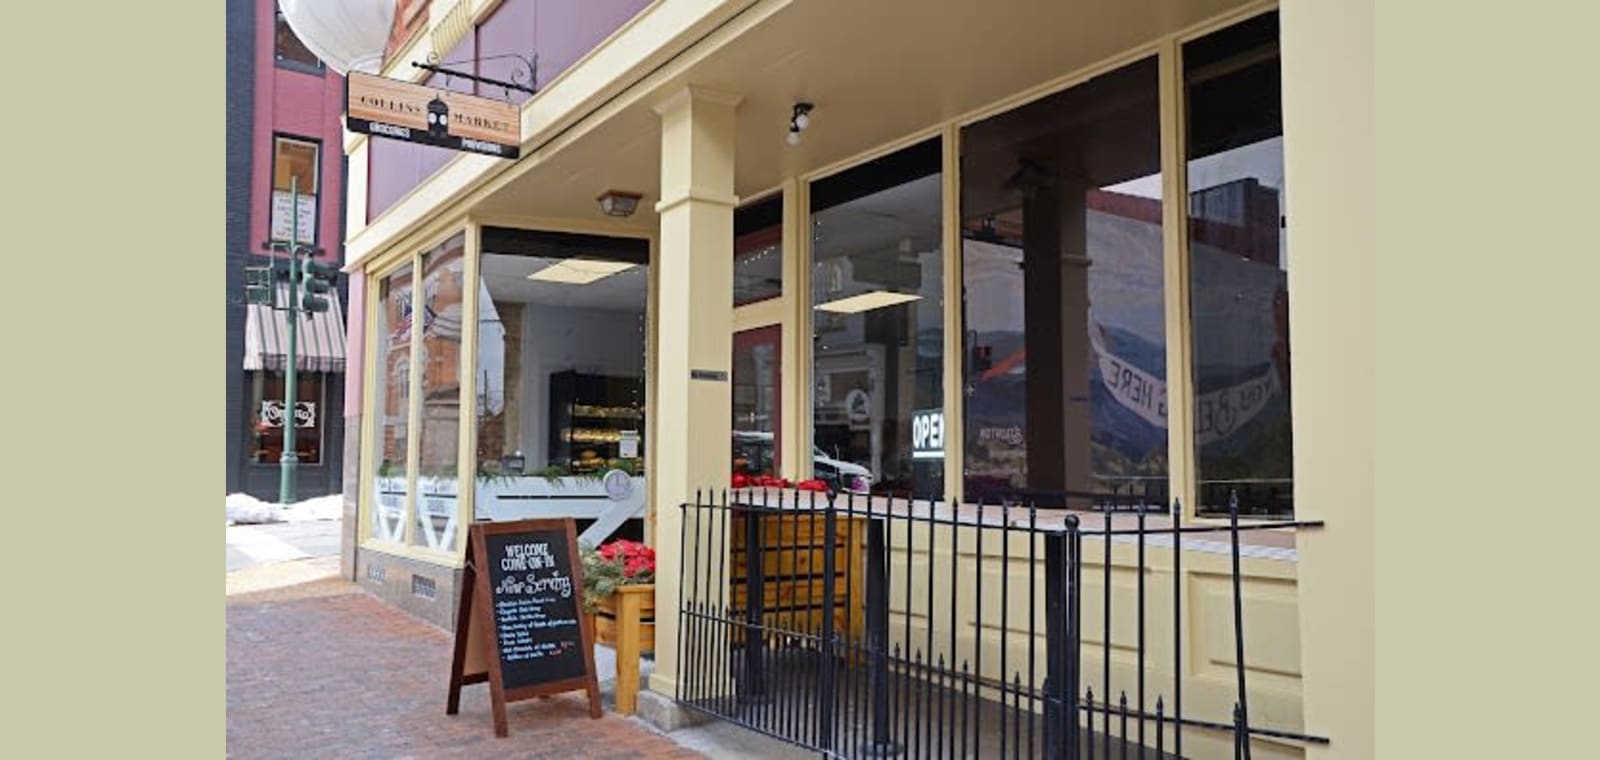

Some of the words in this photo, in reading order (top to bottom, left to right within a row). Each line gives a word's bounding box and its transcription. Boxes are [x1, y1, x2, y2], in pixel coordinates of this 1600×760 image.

[361, 95, 421, 113] COLLINS
[453, 112, 510, 131] MARKET
[505, 543, 549, 558] WELCOME
